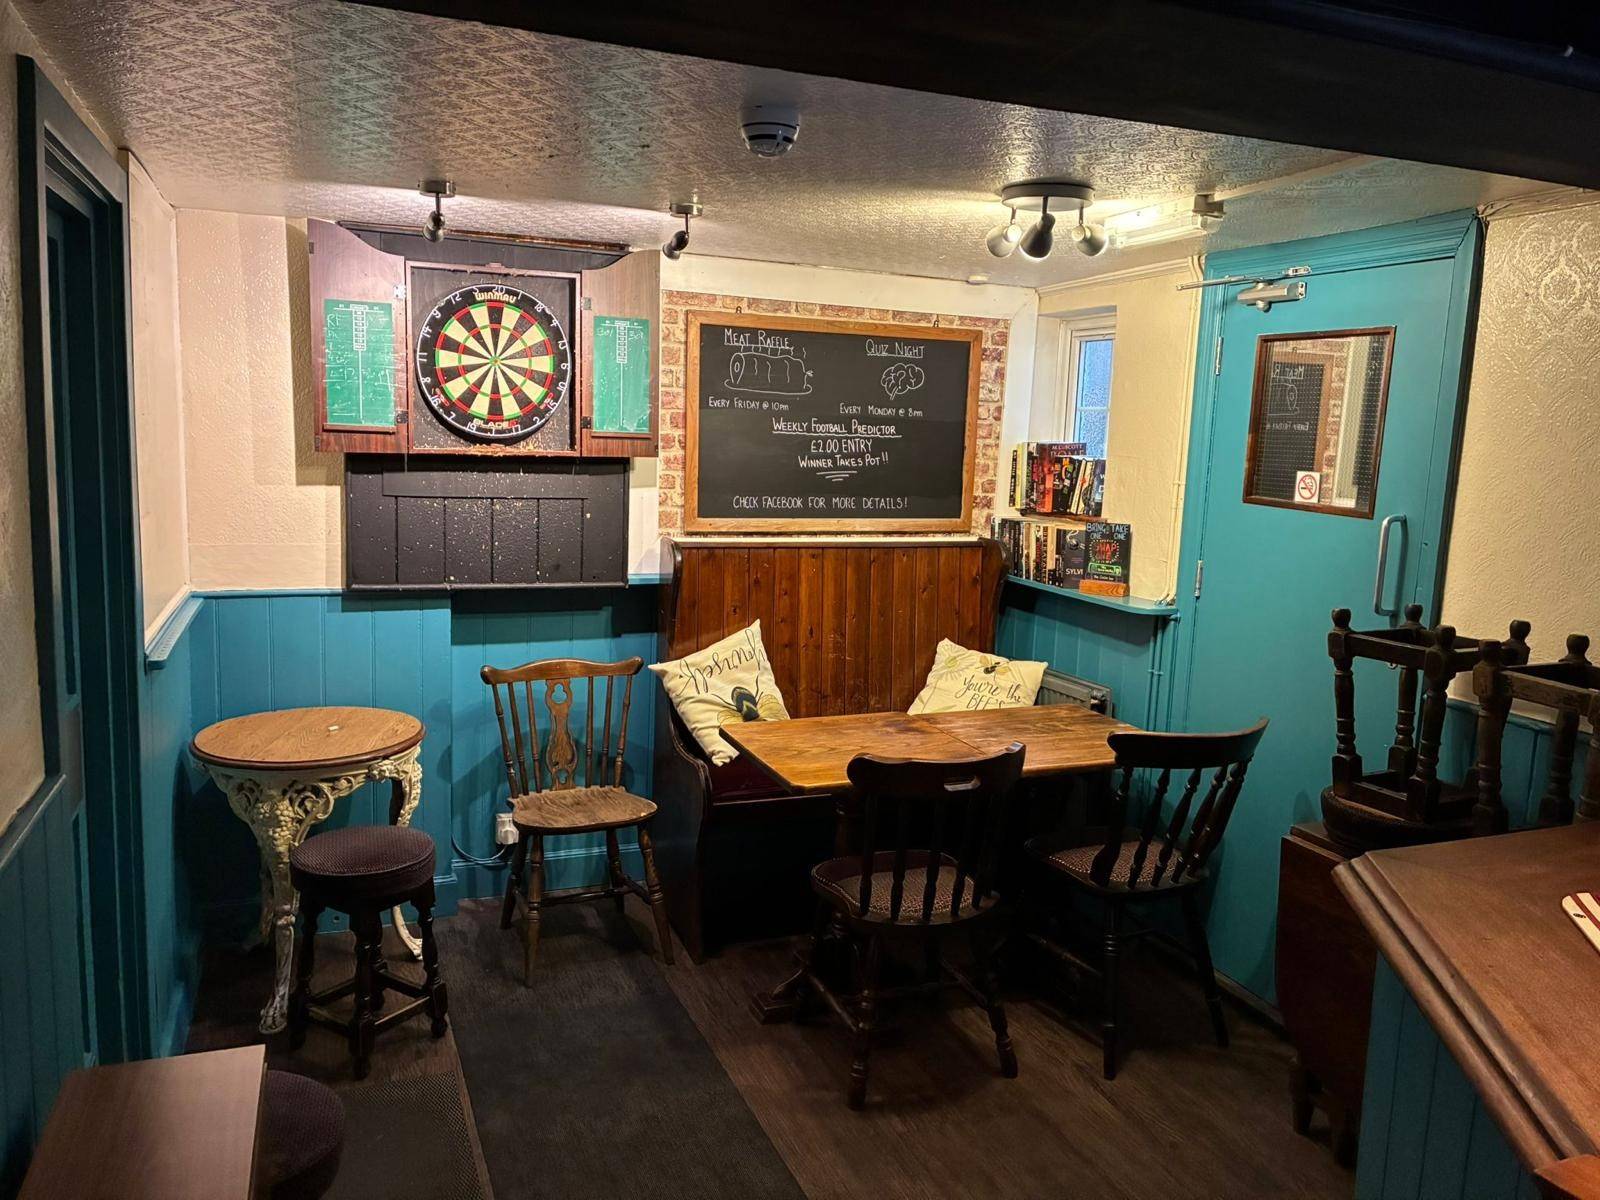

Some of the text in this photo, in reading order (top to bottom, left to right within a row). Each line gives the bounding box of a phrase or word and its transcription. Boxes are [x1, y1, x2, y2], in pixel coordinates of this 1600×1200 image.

[724, 328, 792, 349] MEAT RAFFLE
[866, 339, 925, 358] QUIZ NIGHT
[708, 396, 730, 408] EVERY
[734, 397, 759, 409] FRIDAY
[840, 403, 861, 414] EVERY
[868, 405, 896, 416] MONDAY
[772, 417, 897, 435] WEEKLY FOOTBALL PREDICTOR
[810, 439, 873, 453] £2.00 ENTRY
[798, 455, 834, 468] WINNER
[835, 455, 863, 466] TAKES
[733, 496, 908, 509] CHECK FACEBOOK FOR MORE DETAILS!
